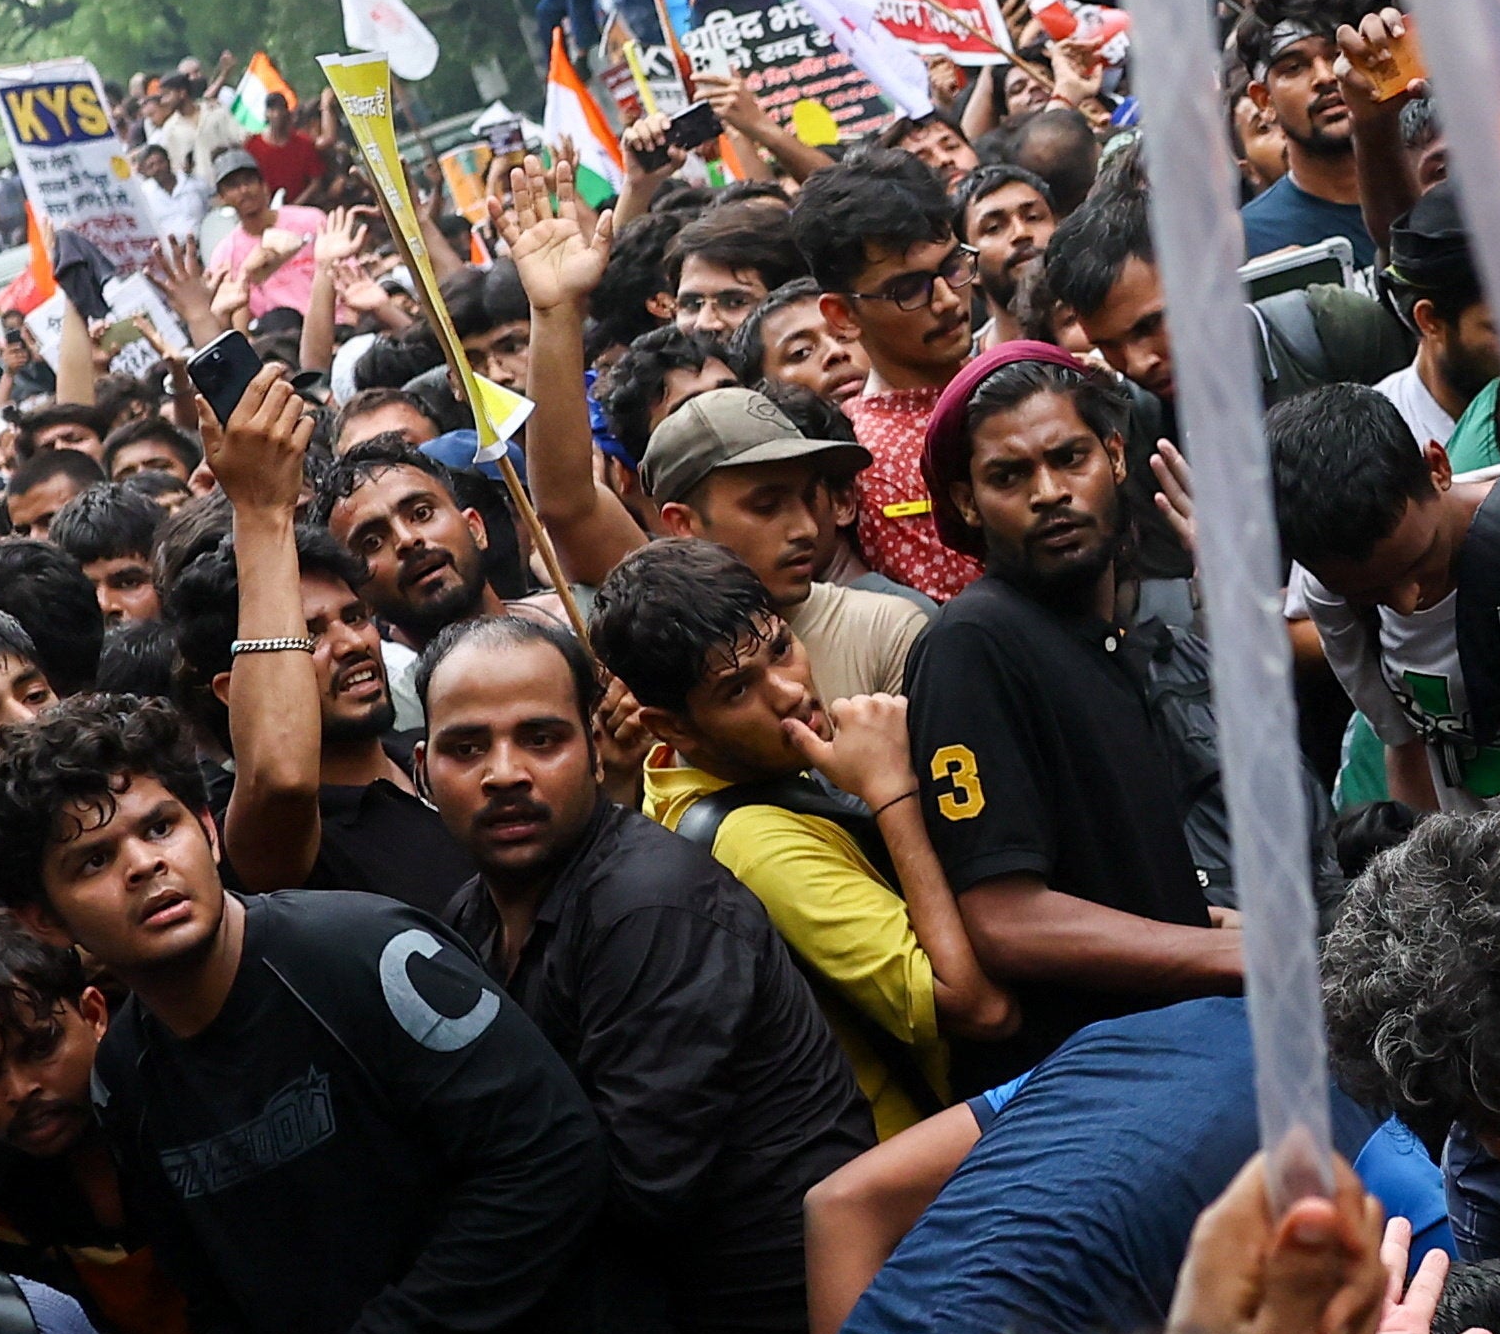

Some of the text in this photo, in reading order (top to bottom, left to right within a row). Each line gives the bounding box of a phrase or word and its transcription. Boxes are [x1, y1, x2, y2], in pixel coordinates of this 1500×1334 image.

[5, 84, 110, 143] KYS
[930, 744, 985, 822] 3
[380, 928, 500, 1052] C
